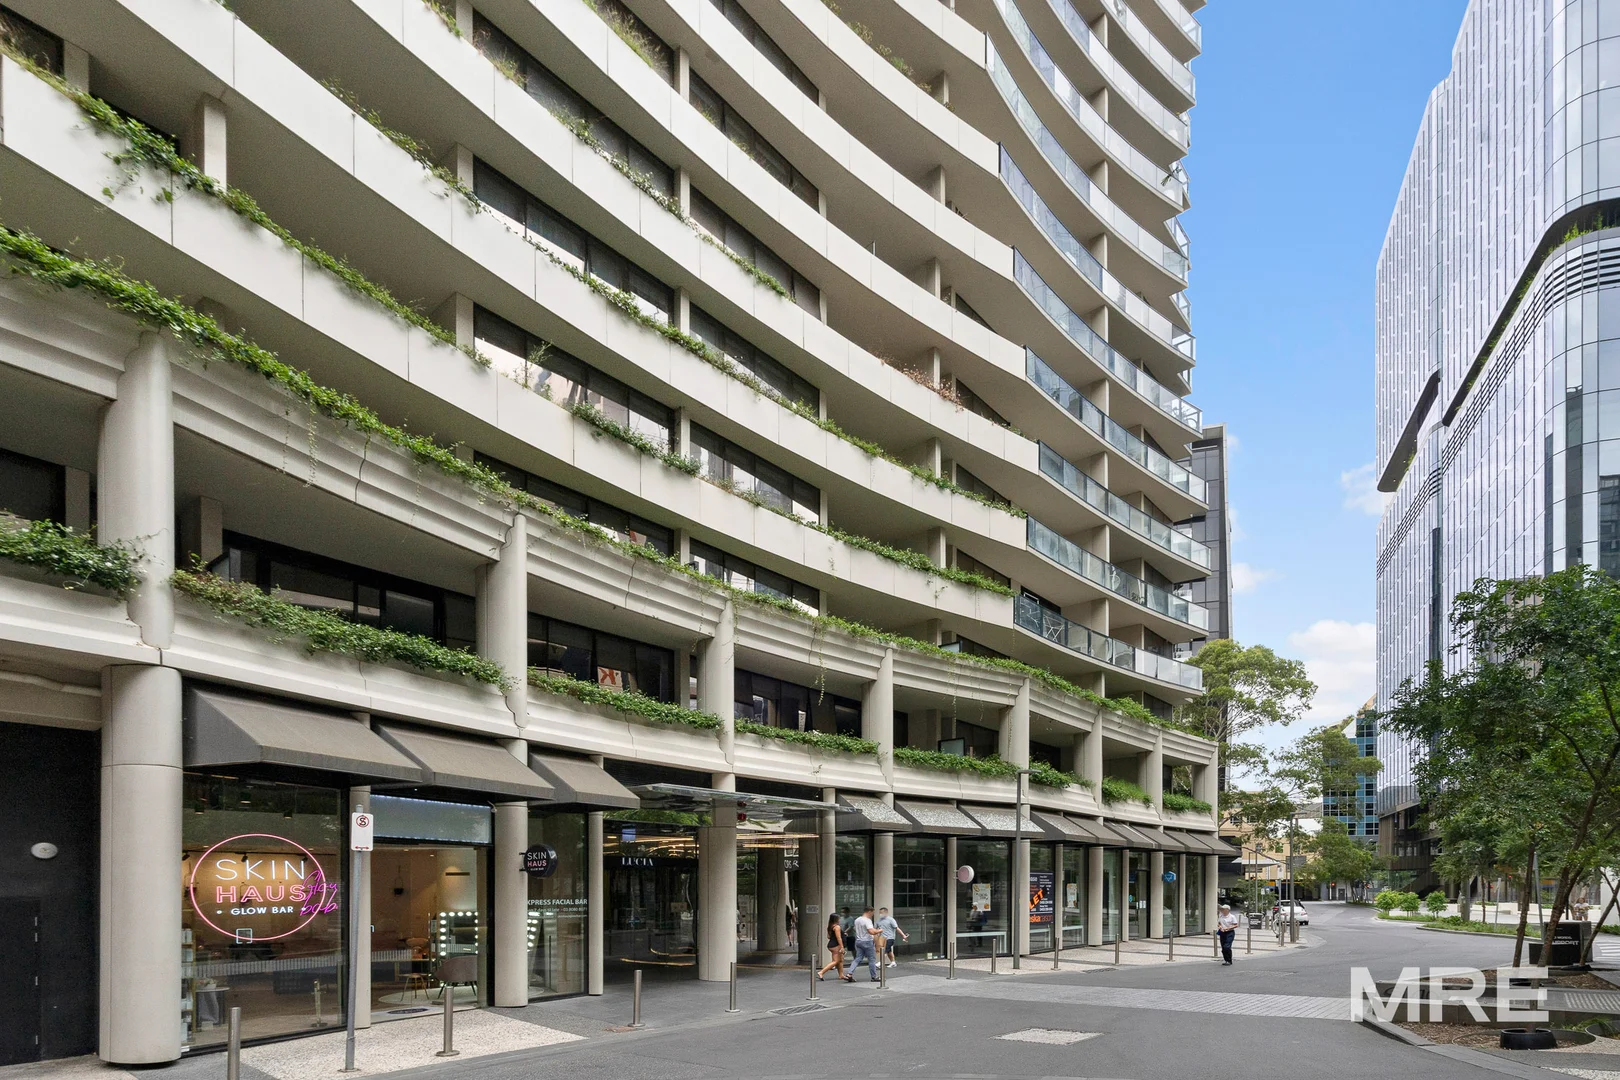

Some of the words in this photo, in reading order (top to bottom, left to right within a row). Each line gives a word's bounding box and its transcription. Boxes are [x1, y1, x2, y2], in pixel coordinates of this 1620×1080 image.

[527, 852, 547, 860] SKIN
[215, 859, 305, 880] SKIN
[216, 884, 306, 903] HAUS
[230, 907, 267, 916] GLOW
[272, 906, 294, 914] BAR
